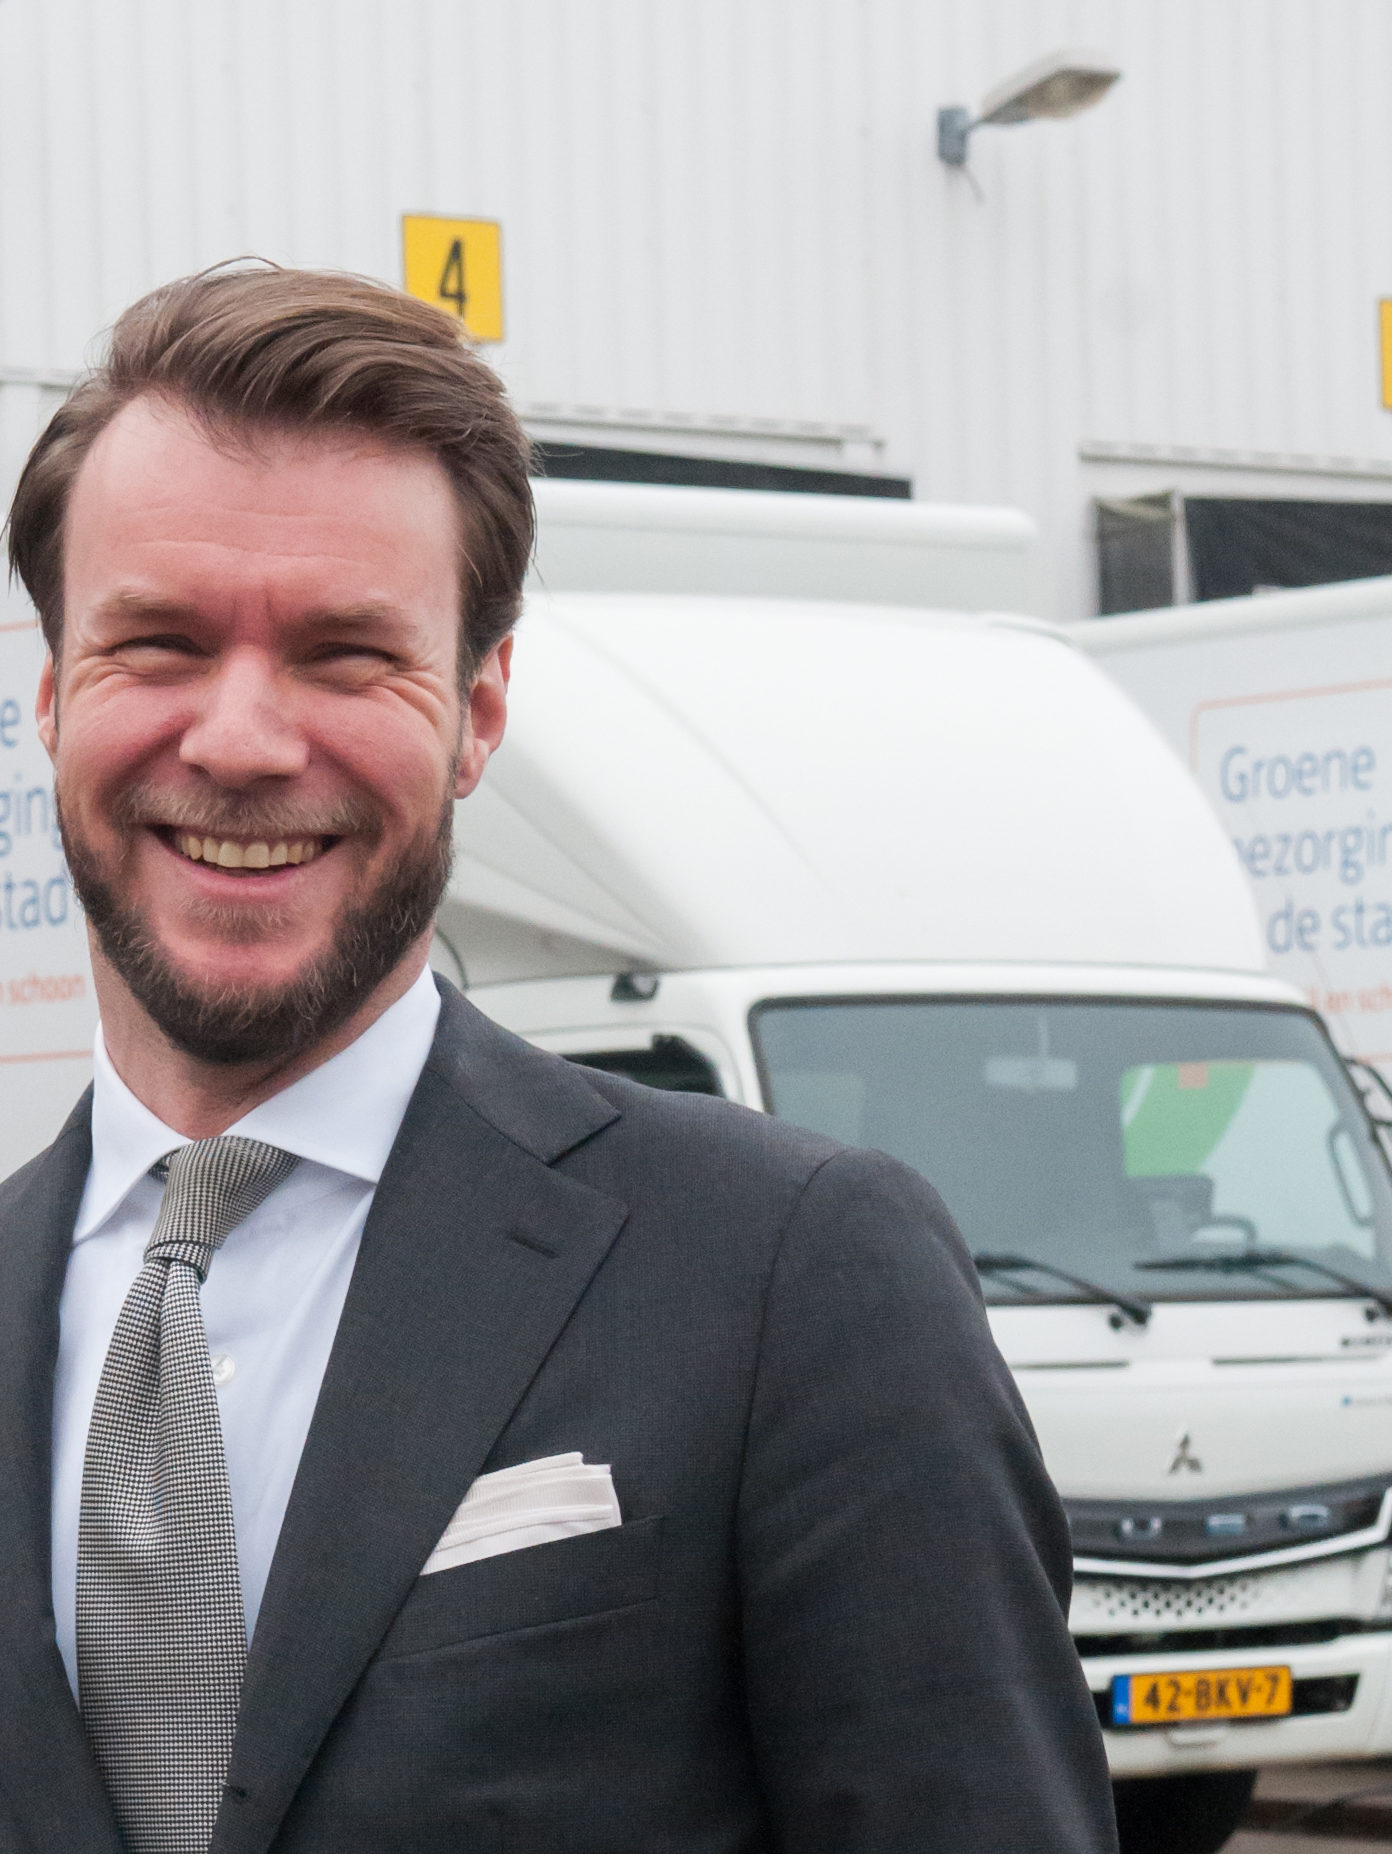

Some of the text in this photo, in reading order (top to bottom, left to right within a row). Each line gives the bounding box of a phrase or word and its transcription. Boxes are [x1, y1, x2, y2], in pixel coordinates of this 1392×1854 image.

[439, 239, 467, 318] 4
[1220, 745, 1377, 803] Groene
[1267, 896, 1321, 953] de
[8, 972, 85, 1006] schoon
[1143, 1673, 1280, 1713] 42-BKV-7
